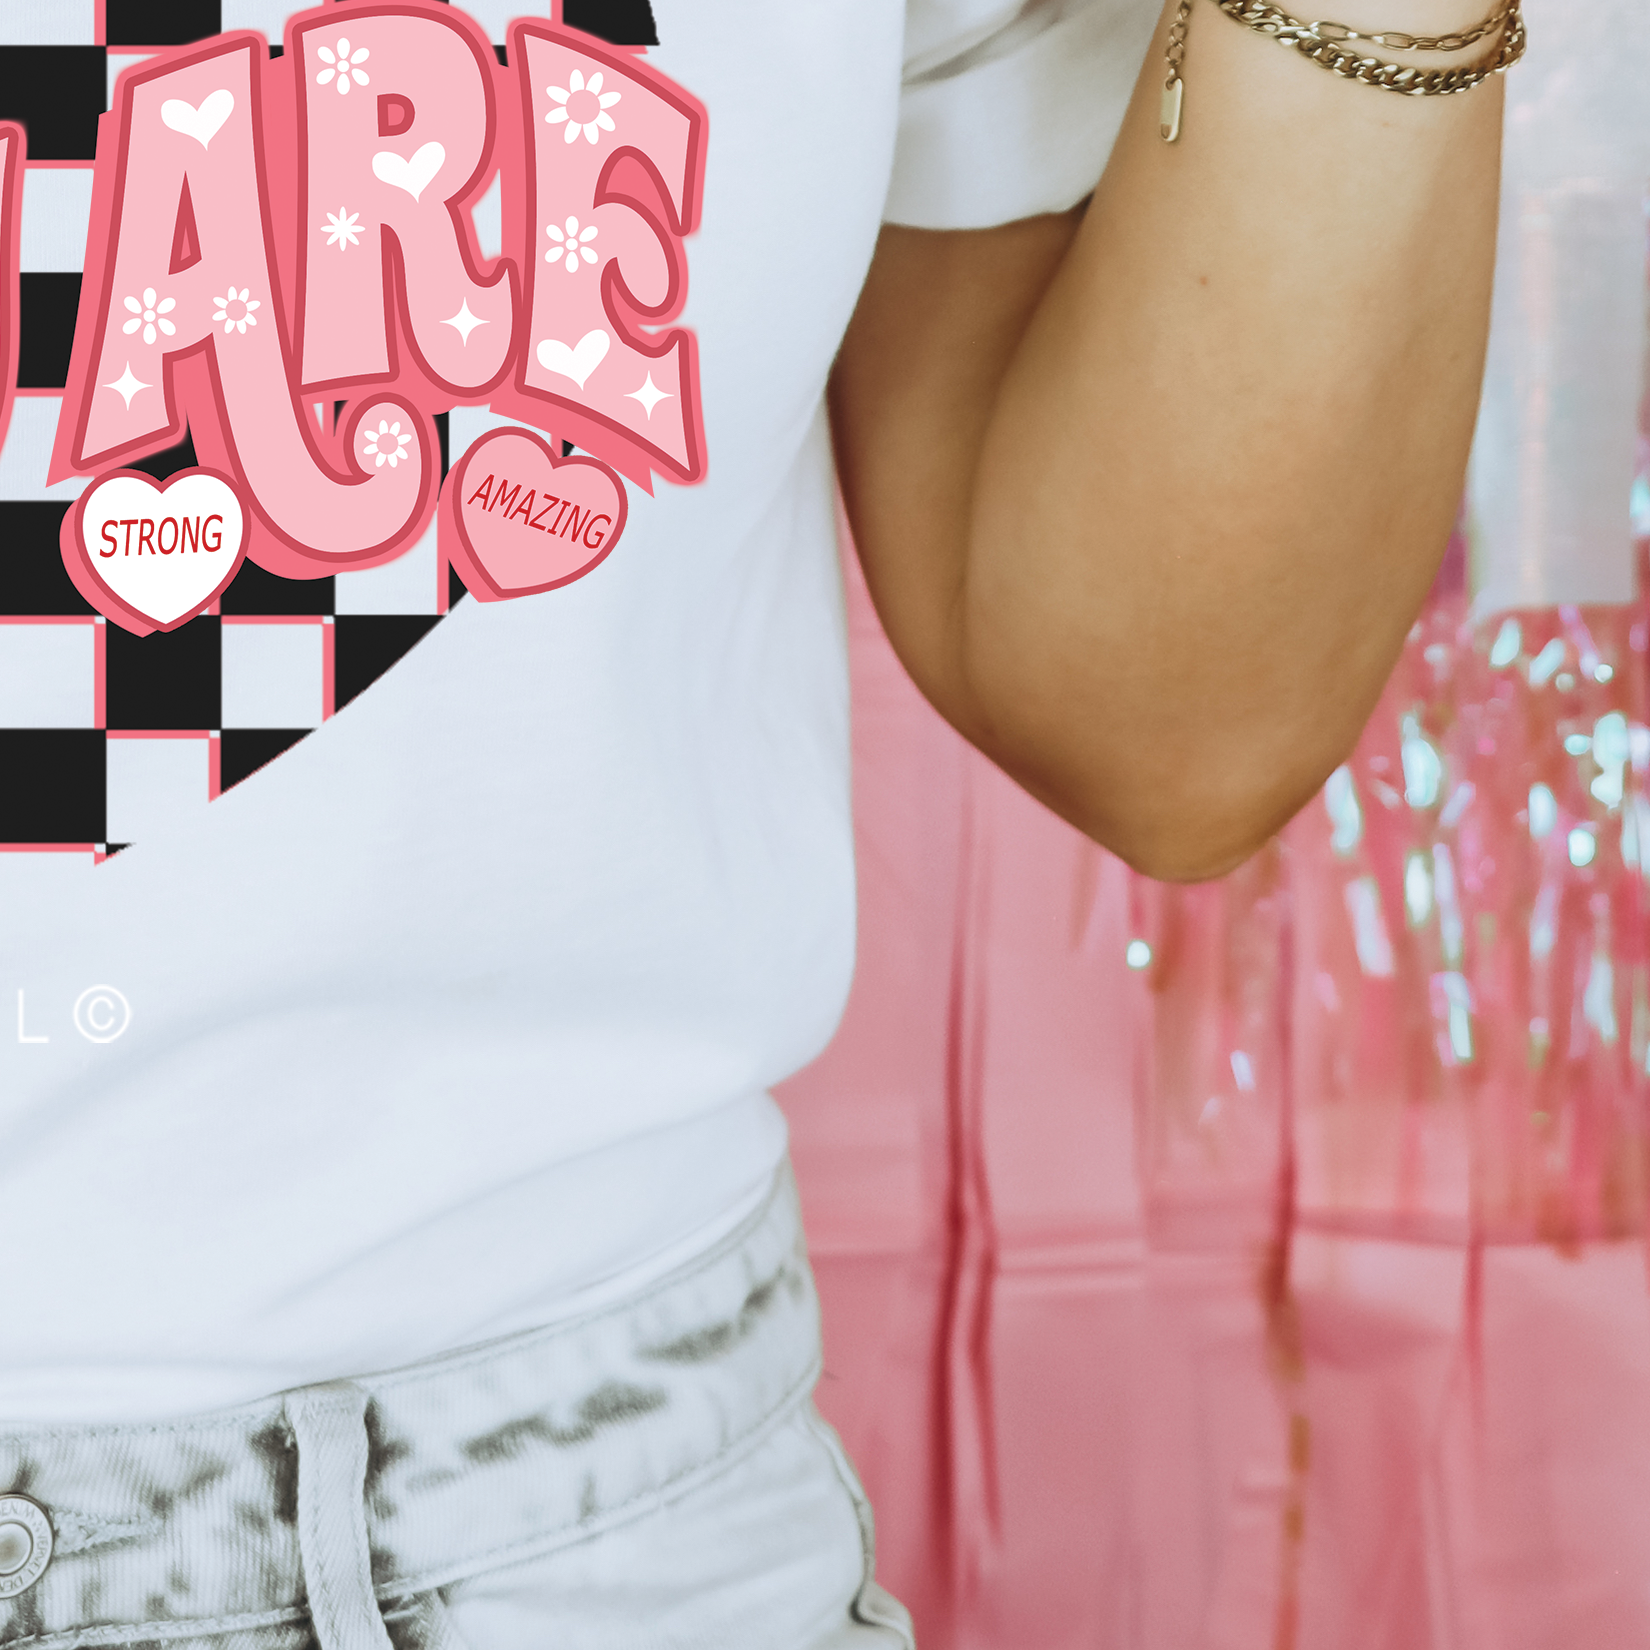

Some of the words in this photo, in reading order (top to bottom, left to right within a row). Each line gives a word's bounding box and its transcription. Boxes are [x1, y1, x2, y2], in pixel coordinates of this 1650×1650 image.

[70, 4, 701, 564] ARE
[98, 514, 224, 559] STRONG
[466, 473, 613, 550] AMAZING
